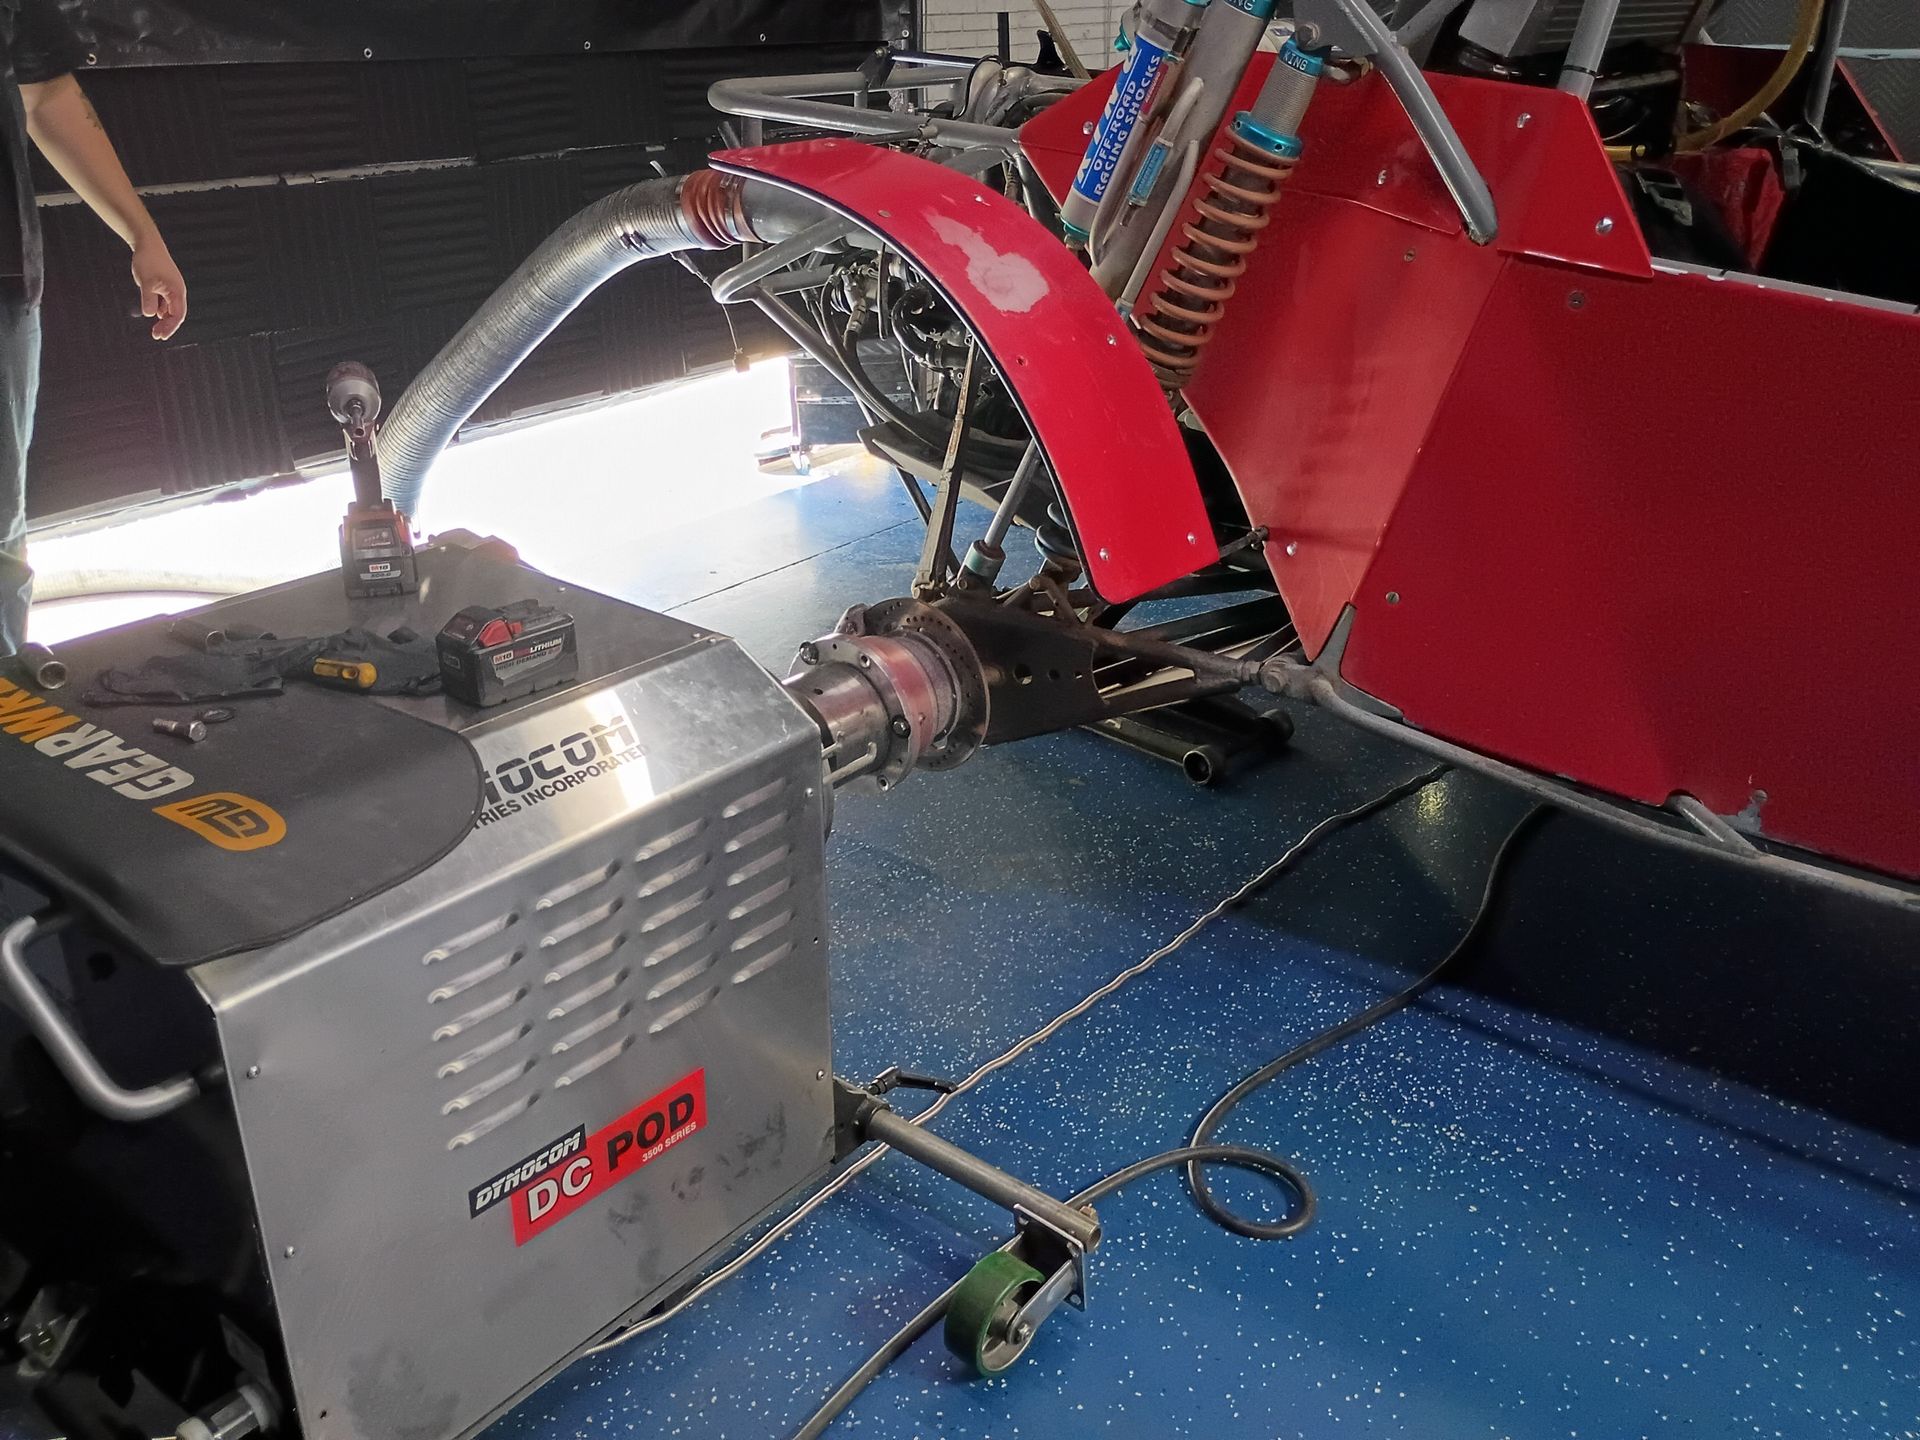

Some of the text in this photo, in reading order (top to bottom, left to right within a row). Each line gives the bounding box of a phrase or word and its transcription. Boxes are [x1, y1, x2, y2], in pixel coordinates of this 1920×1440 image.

[1283, 51, 1308, 71] KING
[1093, 129, 1128, 196] RACING
[1124, 55, 1161, 125] SHOCKS
[1093, 81, 1136, 171] OFF-ROAD
[494, 651, 513, 663] M18
[475, 1131, 581, 1210] DYNOCOM
[528, 1093, 695, 1224] DC POD
[642, 1122, 697, 1163] 3500 SERIES
